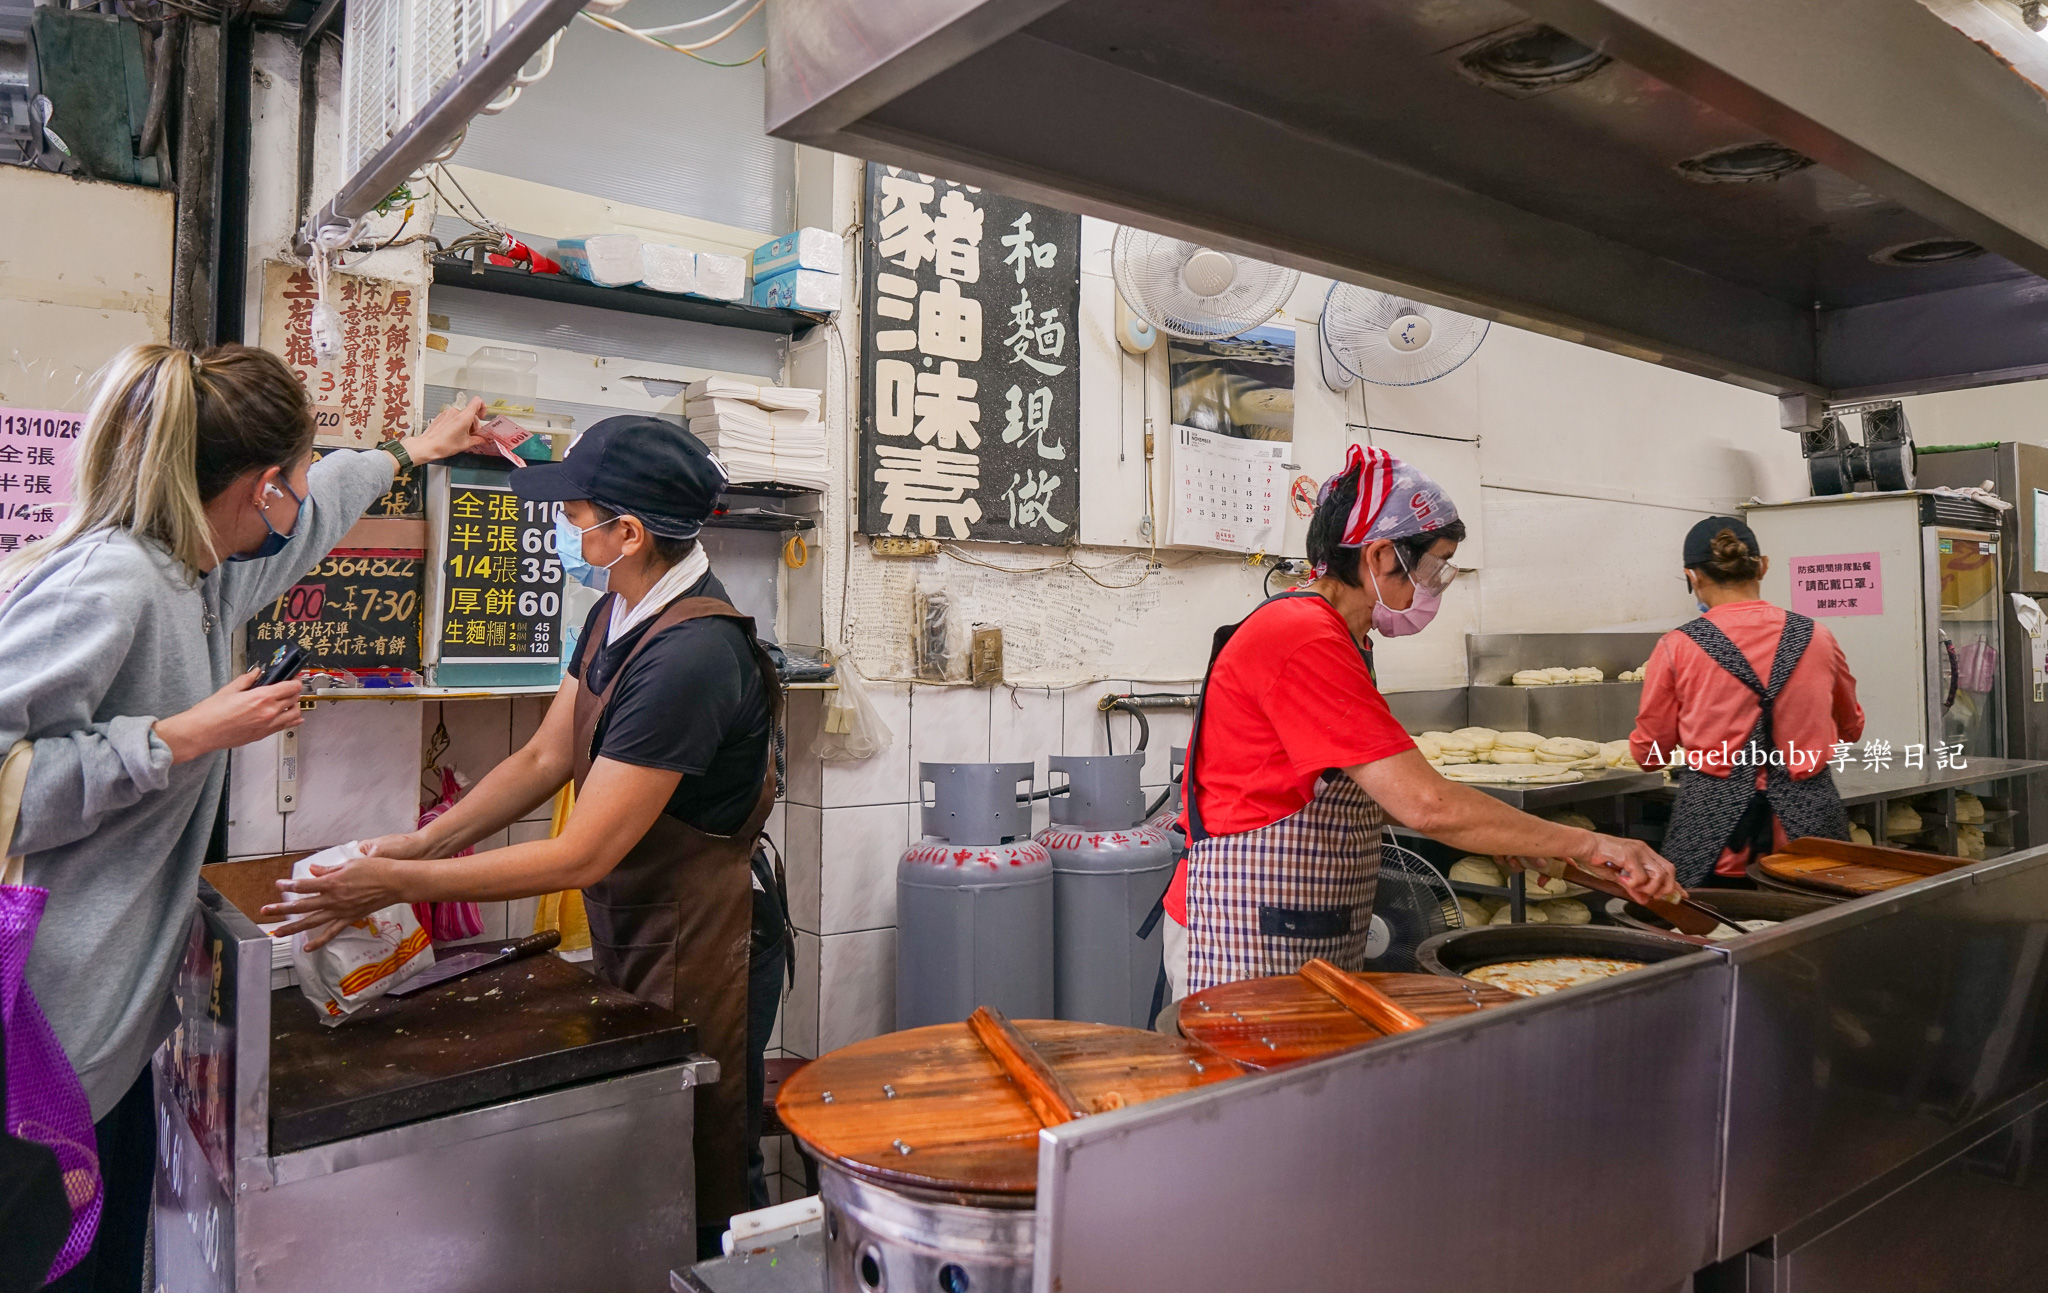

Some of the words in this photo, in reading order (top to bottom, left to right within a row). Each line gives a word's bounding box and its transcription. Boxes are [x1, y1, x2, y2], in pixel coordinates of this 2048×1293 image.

[875, 162, 983, 540] 豬油味素
[1001, 212, 1068, 533] 和麵現做
[452, 491, 520, 522] 全張
[524, 500, 564, 523] 110
[450, 524, 518, 553] 半張
[522, 528, 557, 554] 60
[450, 554, 518, 583] 1/4張
[520, 558, 562, 584] 35
[1797, 561, 1871, 574] 防疫期間排隊點餐
[448, 587, 516, 616] 厚餅
[517, 591, 559, 617] 60
[1817, 598, 1858, 609] 謝謝大家
[534, 632, 550, 642] 90
[535, 622, 550, 632] 45
[529, 643, 549, 653] 120
